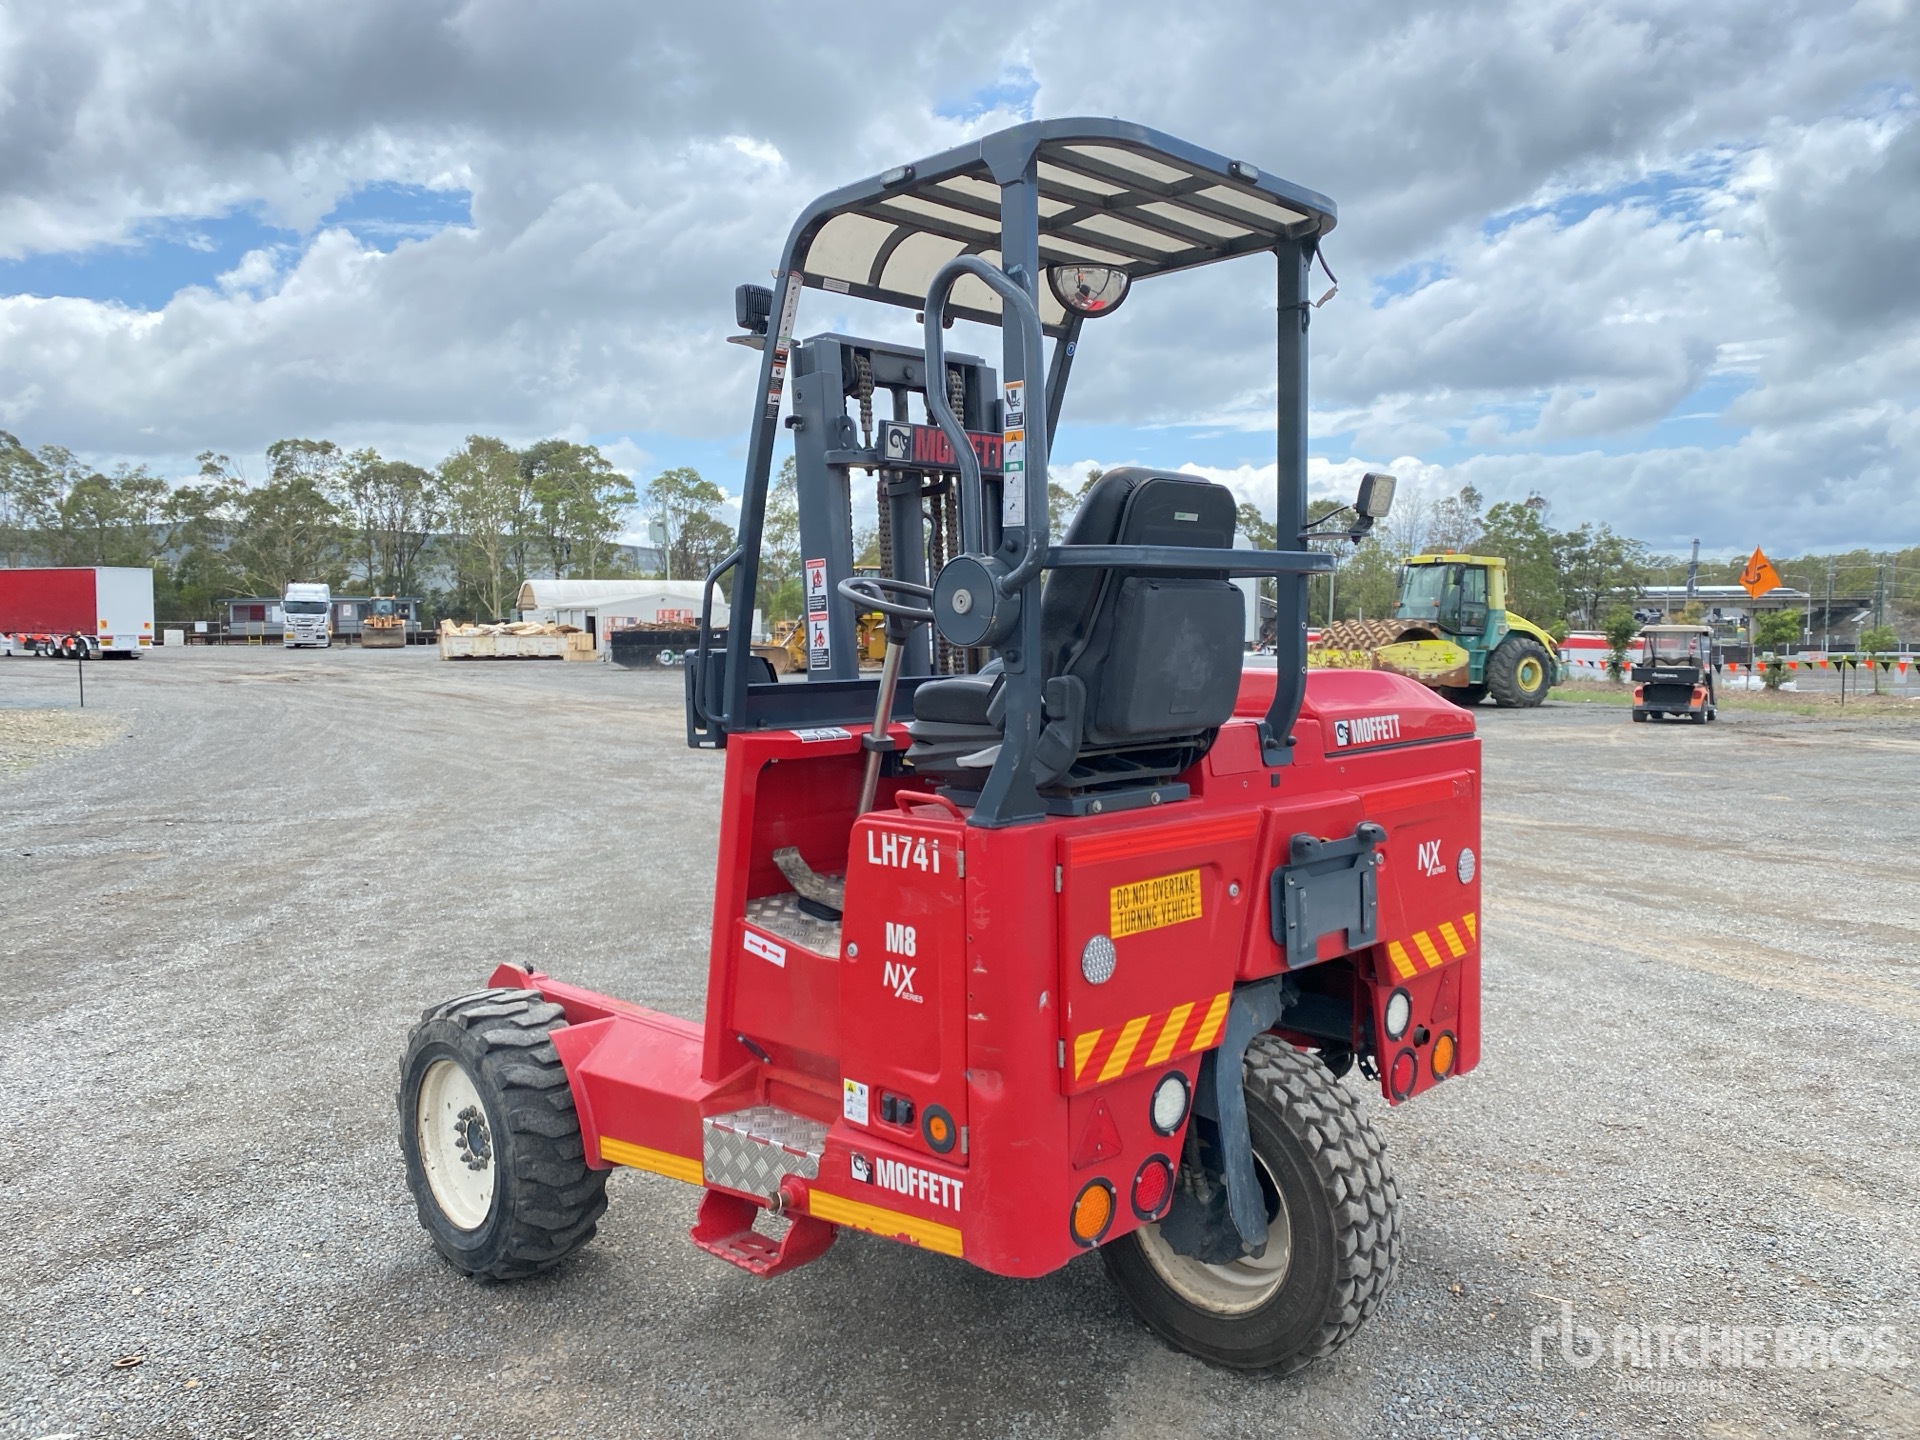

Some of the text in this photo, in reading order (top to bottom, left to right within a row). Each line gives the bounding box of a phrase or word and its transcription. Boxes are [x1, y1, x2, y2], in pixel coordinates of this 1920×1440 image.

[1350, 714, 1400, 744] MOFFETT
[1418, 839, 1441, 877] NX
[1117, 873, 1195, 910] DO NOT OVERTAKE
[1119, 896, 1196, 933] TURNING VEHICLE
[886, 922, 916, 957] M8
[883, 961, 917, 998] NX
[876, 1157, 963, 1212] MOFFETT
